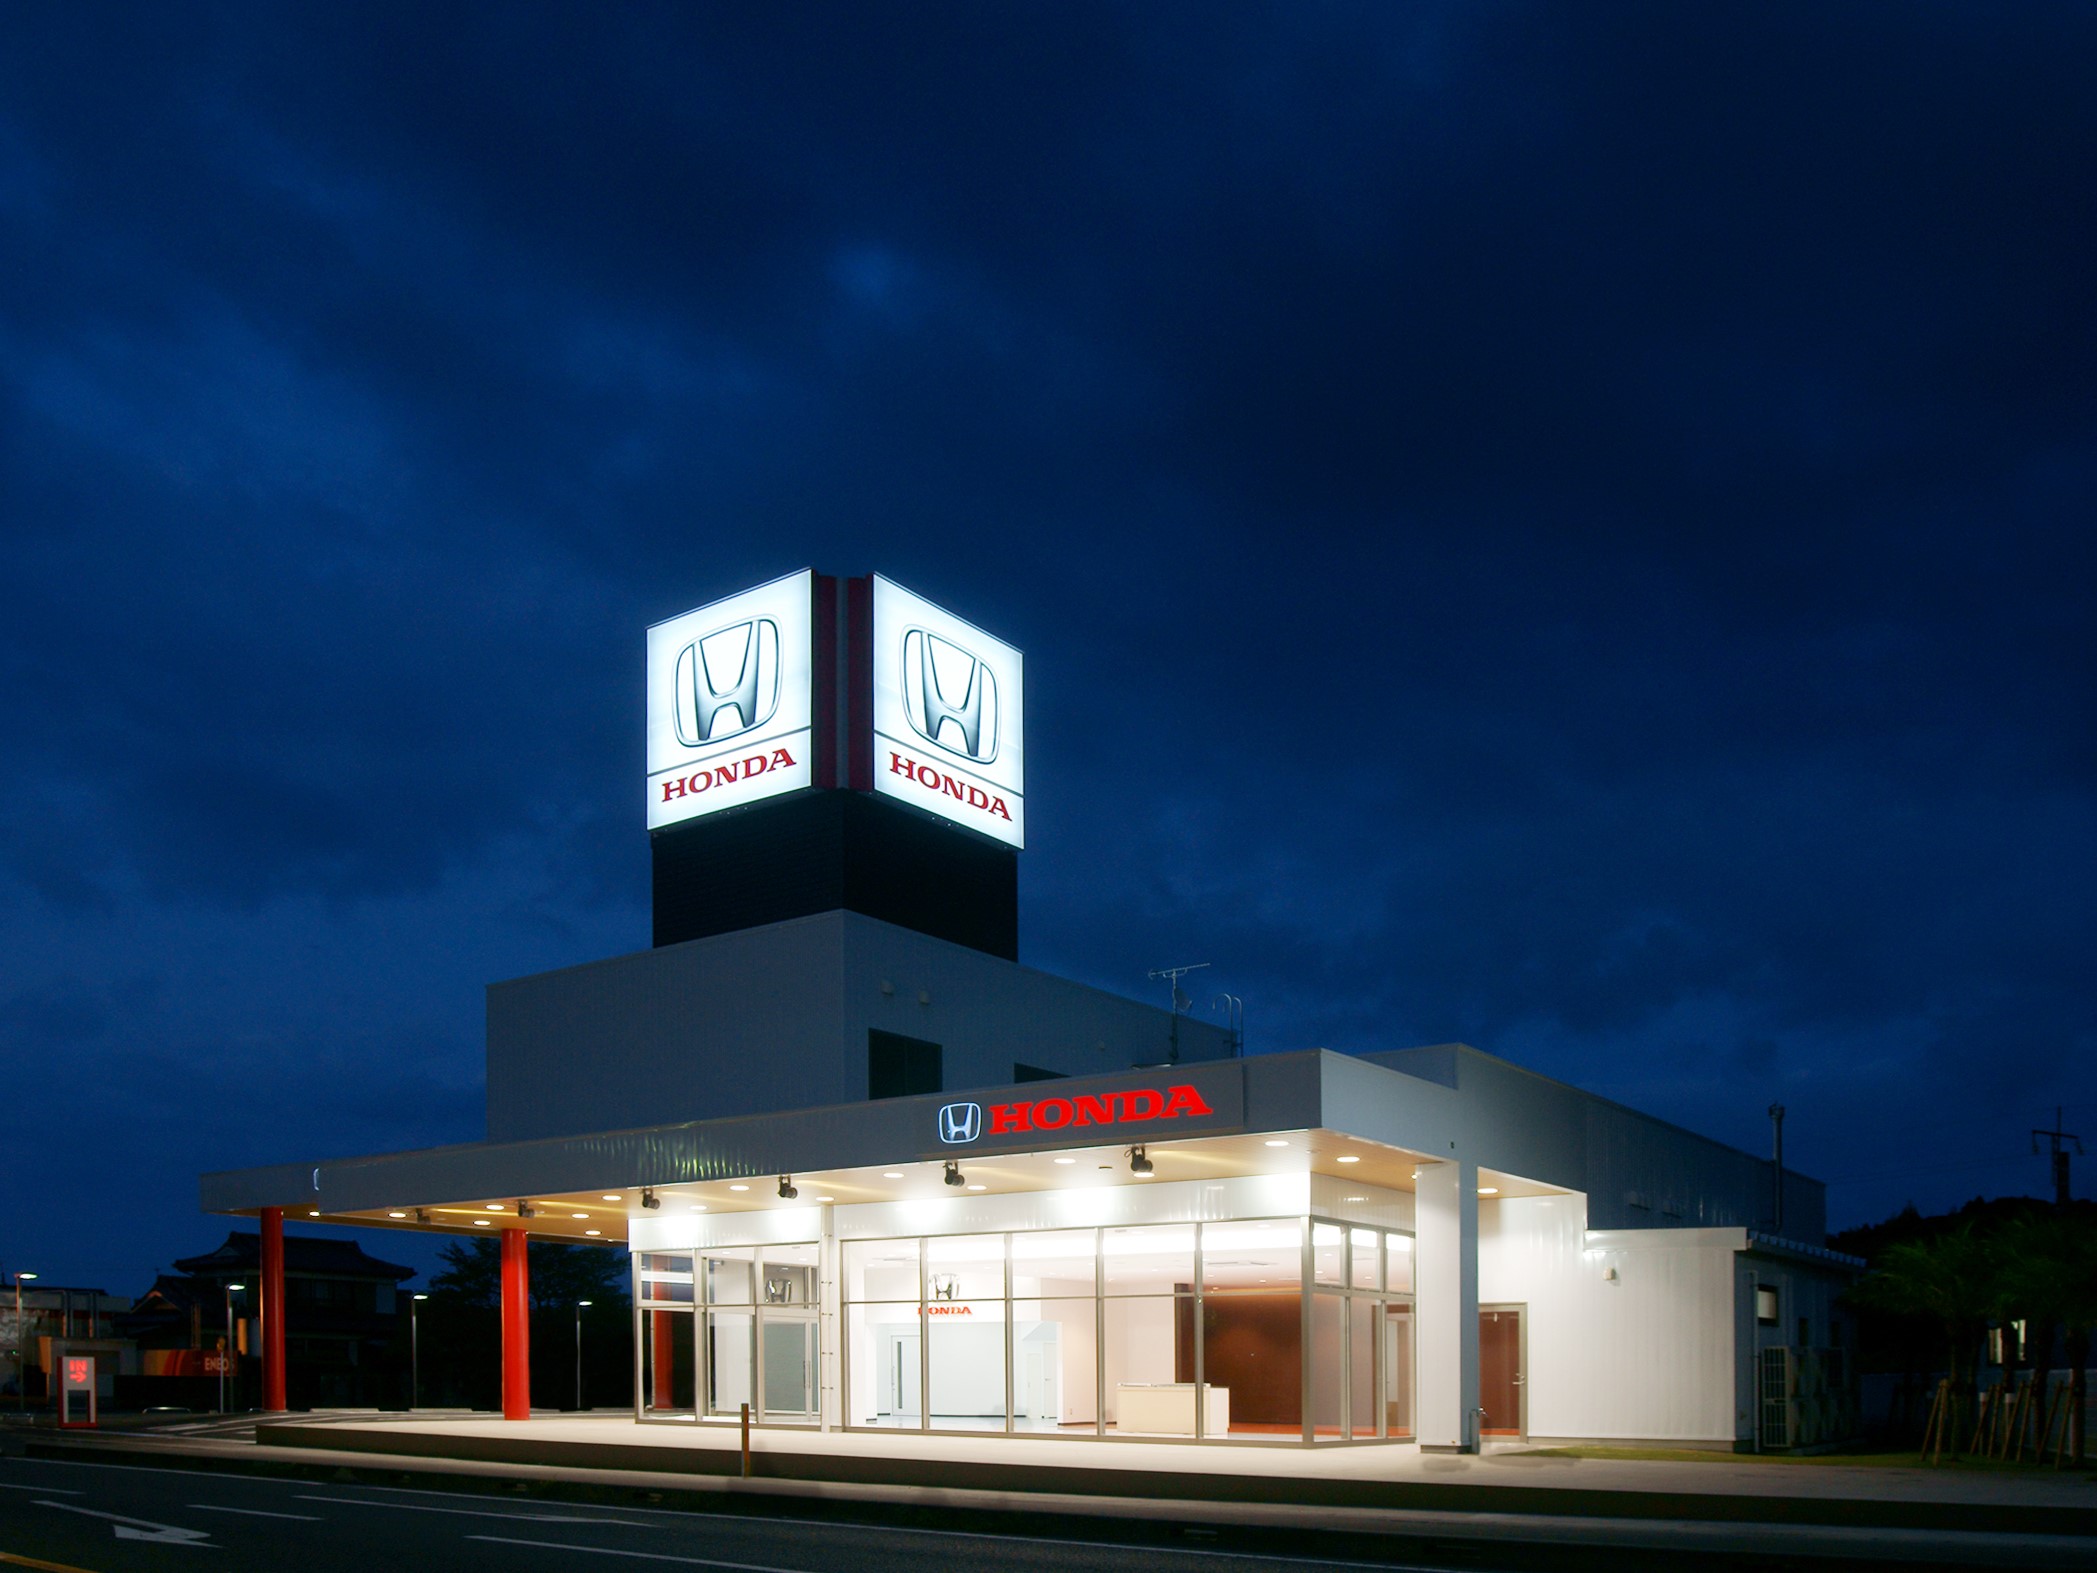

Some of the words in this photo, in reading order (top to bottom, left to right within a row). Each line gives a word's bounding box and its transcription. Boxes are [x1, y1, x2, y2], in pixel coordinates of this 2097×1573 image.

[662, 748, 796, 801] HONDA
[889, 752, 1012, 821] HONDA
[988, 1084, 1214, 1135] HONDA
[69, 1359, 88, 1372] IN
